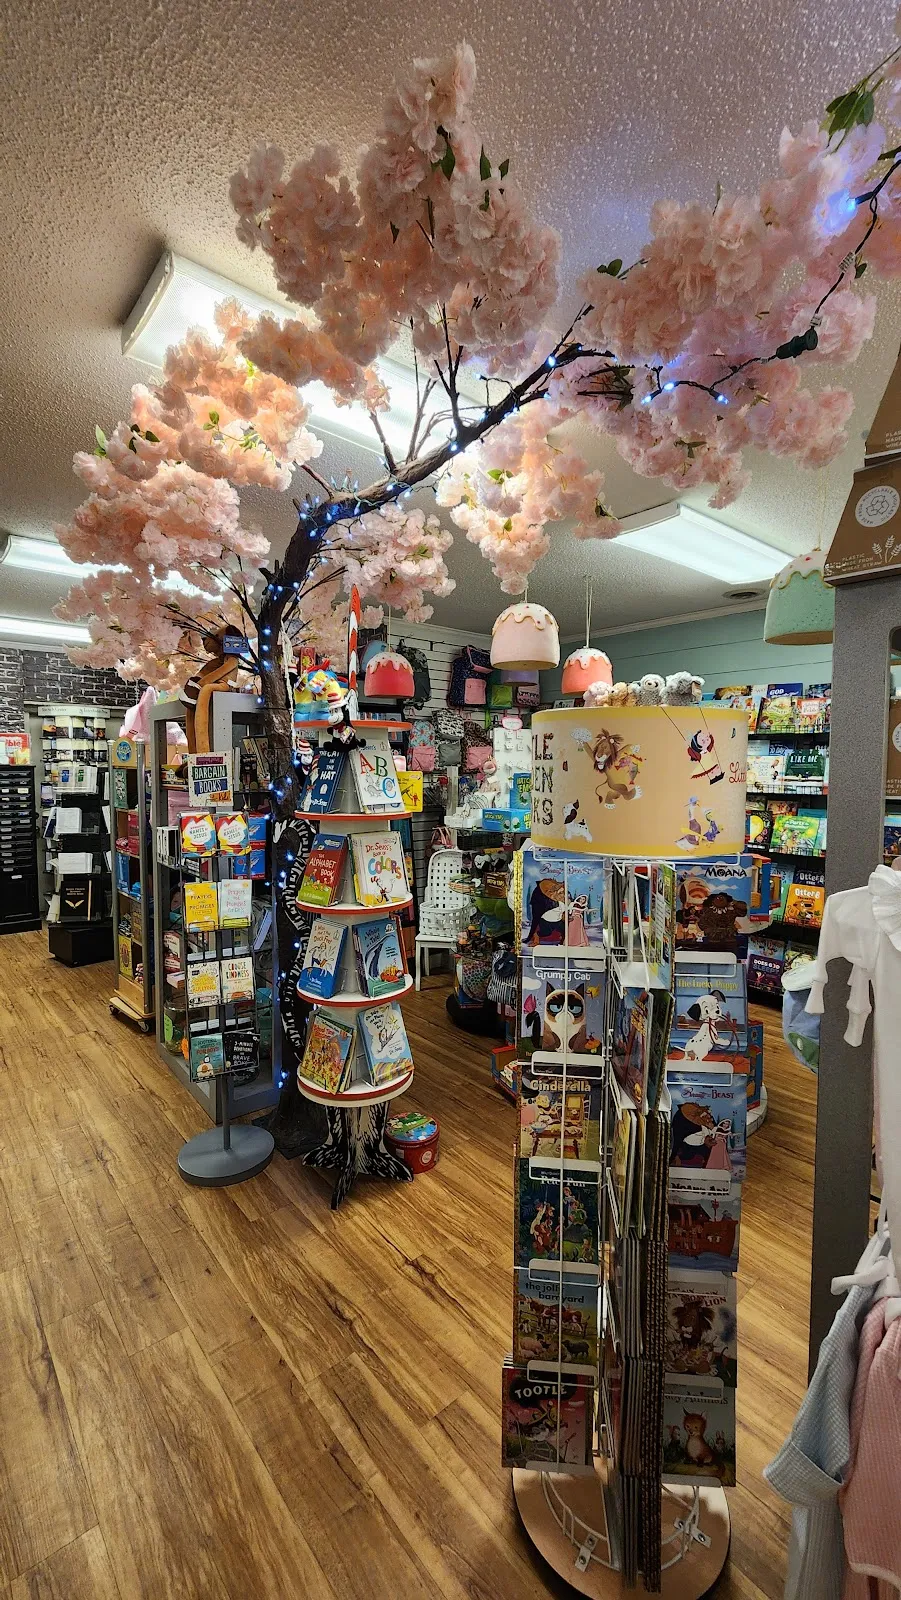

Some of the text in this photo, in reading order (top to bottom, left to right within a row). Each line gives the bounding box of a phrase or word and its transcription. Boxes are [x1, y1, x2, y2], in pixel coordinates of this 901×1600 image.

[842, 553, 865, 561] PLASTIC
[790, 755, 819, 763] LIKE ME
[194, 765, 226, 779] BARGAIN
[320, 770, 336, 780] HAT
[199, 779, 222, 793] BOOKS
[309, 857, 337, 869] ALPHABET
[368, 856, 402, 879] COLORS
[320, 868, 335, 880] BOOK
[704, 866, 748, 877] MOANA
[799, 872, 820, 882] Otter
[794, 888, 816, 897] Otter
[535, 969, 591, 981] Grumpy Cat
[678, 978, 692, 988] The
[715, 979, 738, 992] Puppy
[530, 1079, 592, 1092] Cinderella
[711, 1089, 735, 1099] BEAST
[525, 1281, 541, 1291] the
[704, 1296, 727, 1307] LION
[514, 1383, 568, 1399] TOOTLE
